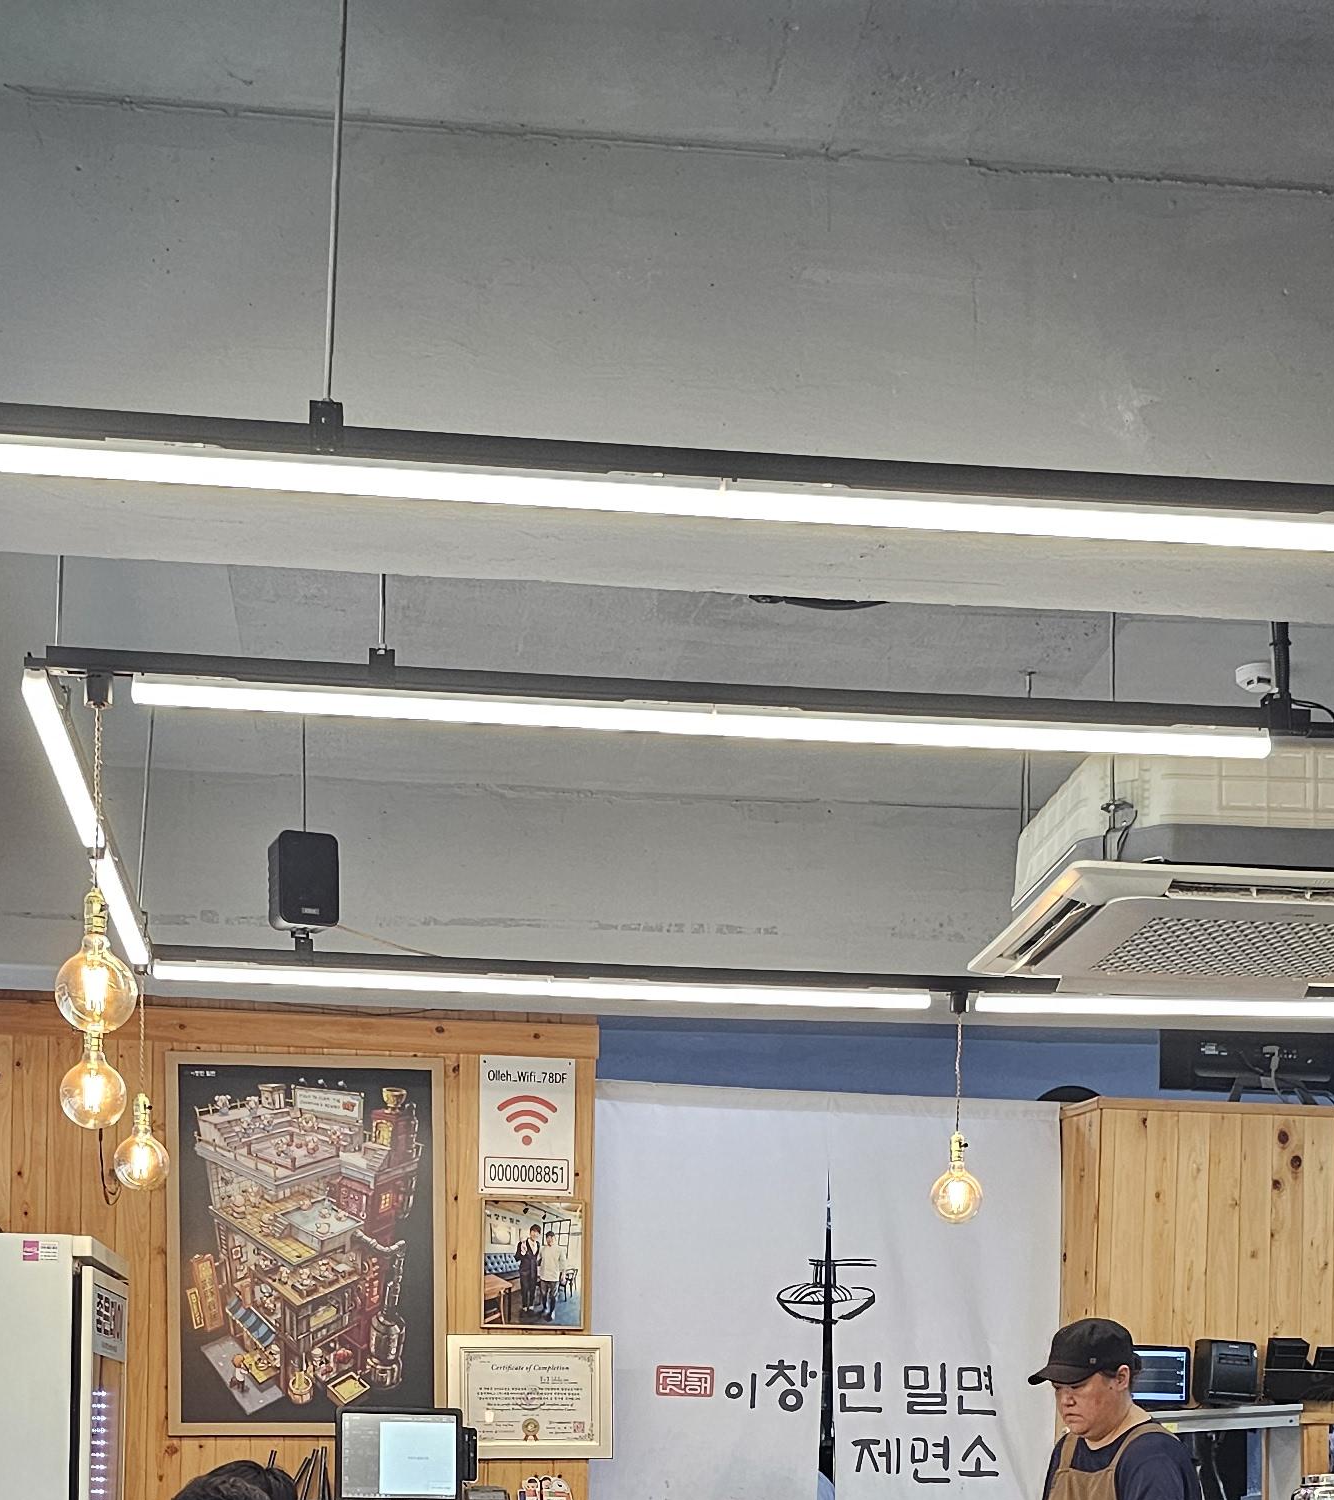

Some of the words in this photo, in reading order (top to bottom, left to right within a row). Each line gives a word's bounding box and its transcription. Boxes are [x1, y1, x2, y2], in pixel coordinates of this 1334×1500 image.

[487, 1069, 568, 1084] Olleh_Wifi_78DF
[489, 1164, 564, 1184] 0000008851
[490, 1363, 525, 1371] Certificate
[525, 1364, 533, 1373] of
[533, 1364, 570, 1373] Completion
[903, 1362, 997, 1416] 밀면
[851, 1434, 1000, 1484] 제면소
